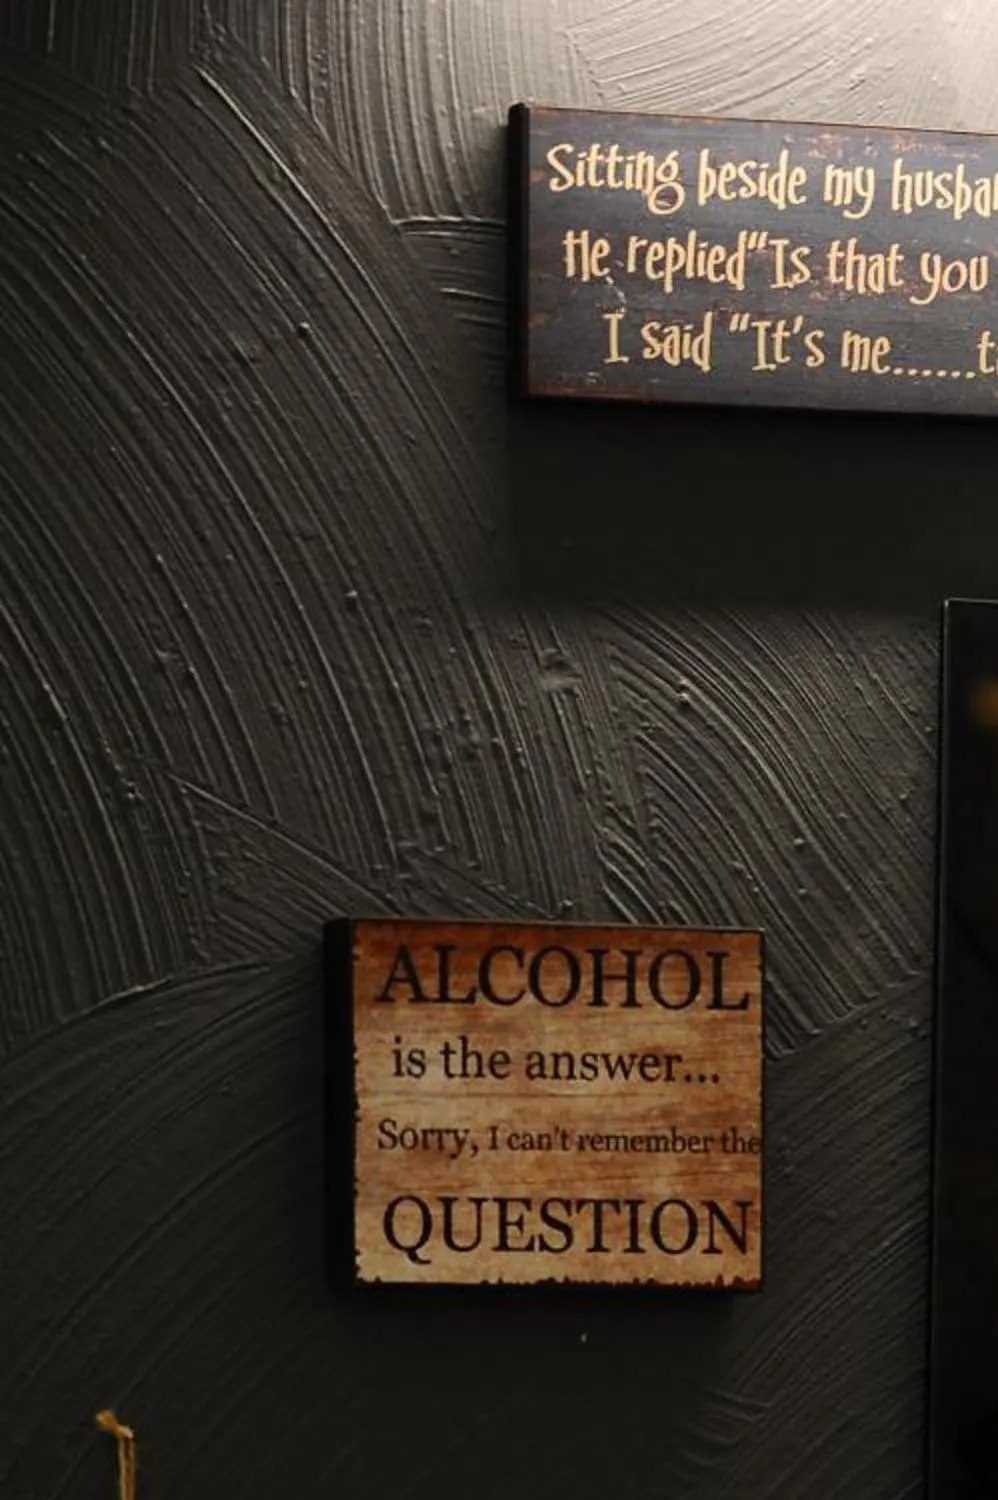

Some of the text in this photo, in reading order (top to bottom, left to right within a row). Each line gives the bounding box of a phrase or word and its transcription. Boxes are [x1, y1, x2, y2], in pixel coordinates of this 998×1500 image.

[546, 143, 686, 215] Sitting
[699, 148, 808, 211] beside
[824, 163, 876, 220] my
[562, 229, 612, 283] He
[826, 237, 906, 296] that
[910, 249, 991, 306] you
[602, 312, 631, 364] I
[640, 311, 714, 374] said
[374, 943, 752, 1013] ALCOHOL
[392, 1034, 721, 1085] is the answer...
[376, 1117, 763, 1160] Sorry, I can't remember the
[382, 1194, 754, 1266] QUESTION
